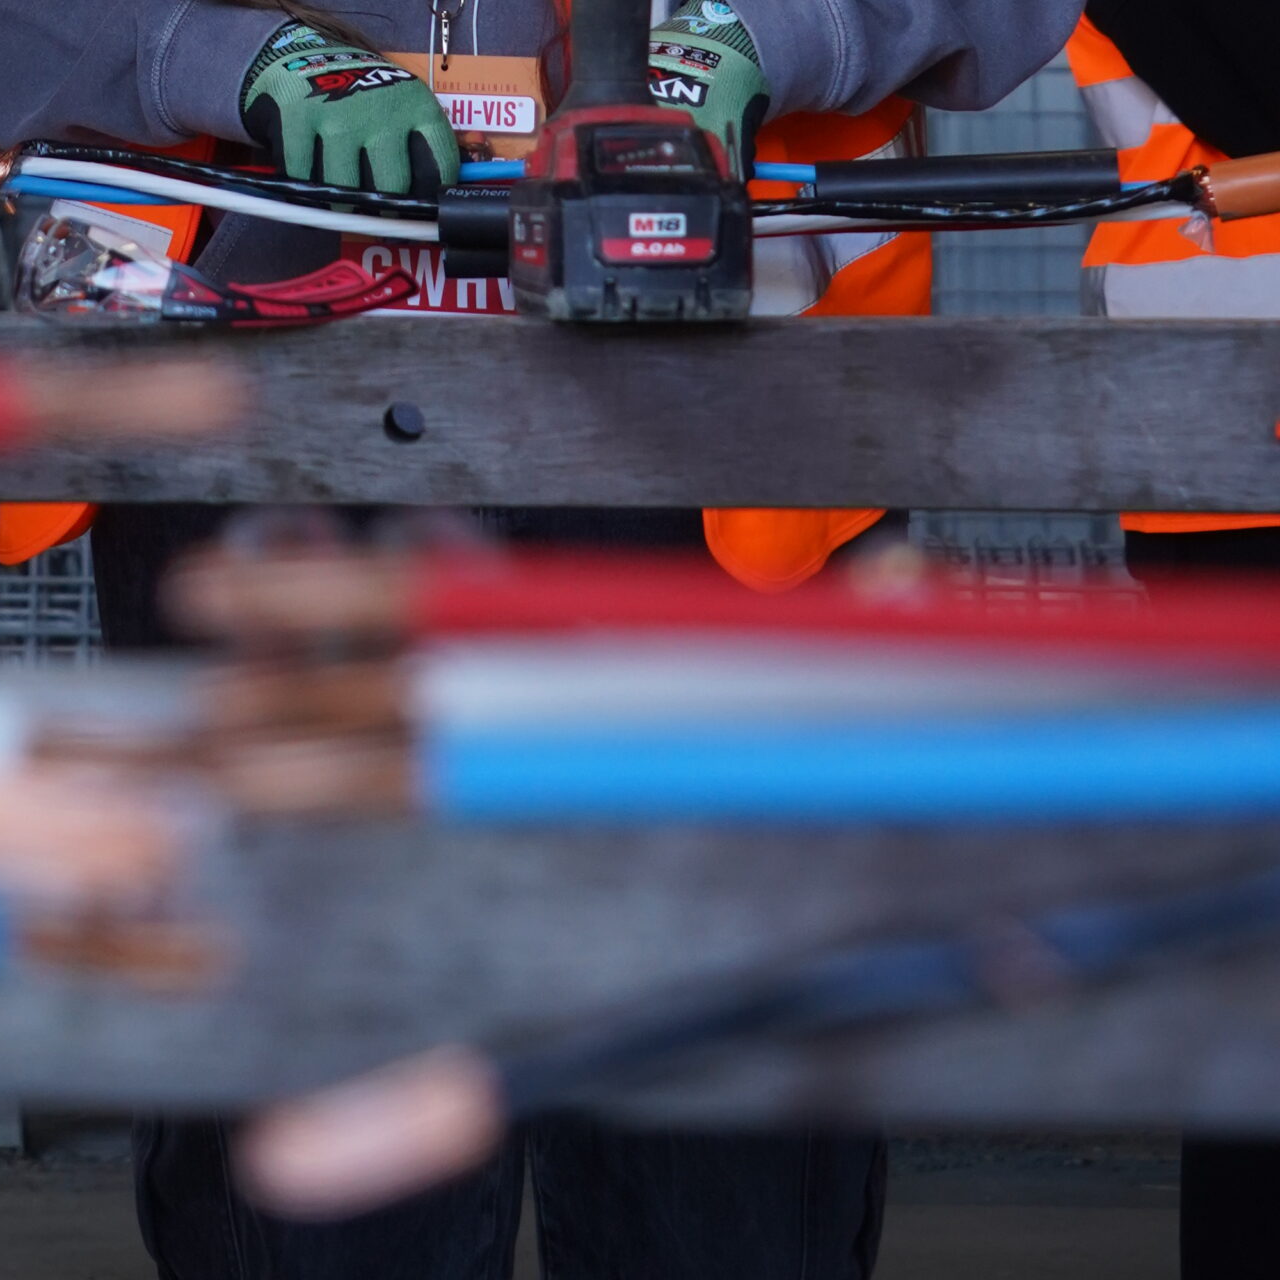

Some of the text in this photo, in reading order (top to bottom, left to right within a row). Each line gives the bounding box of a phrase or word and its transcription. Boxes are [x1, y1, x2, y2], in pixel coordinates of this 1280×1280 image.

[452, 99, 517, 127] HI-VIS
[445, 187, 512, 198] Raychem
[634, 217, 681, 232] M18
